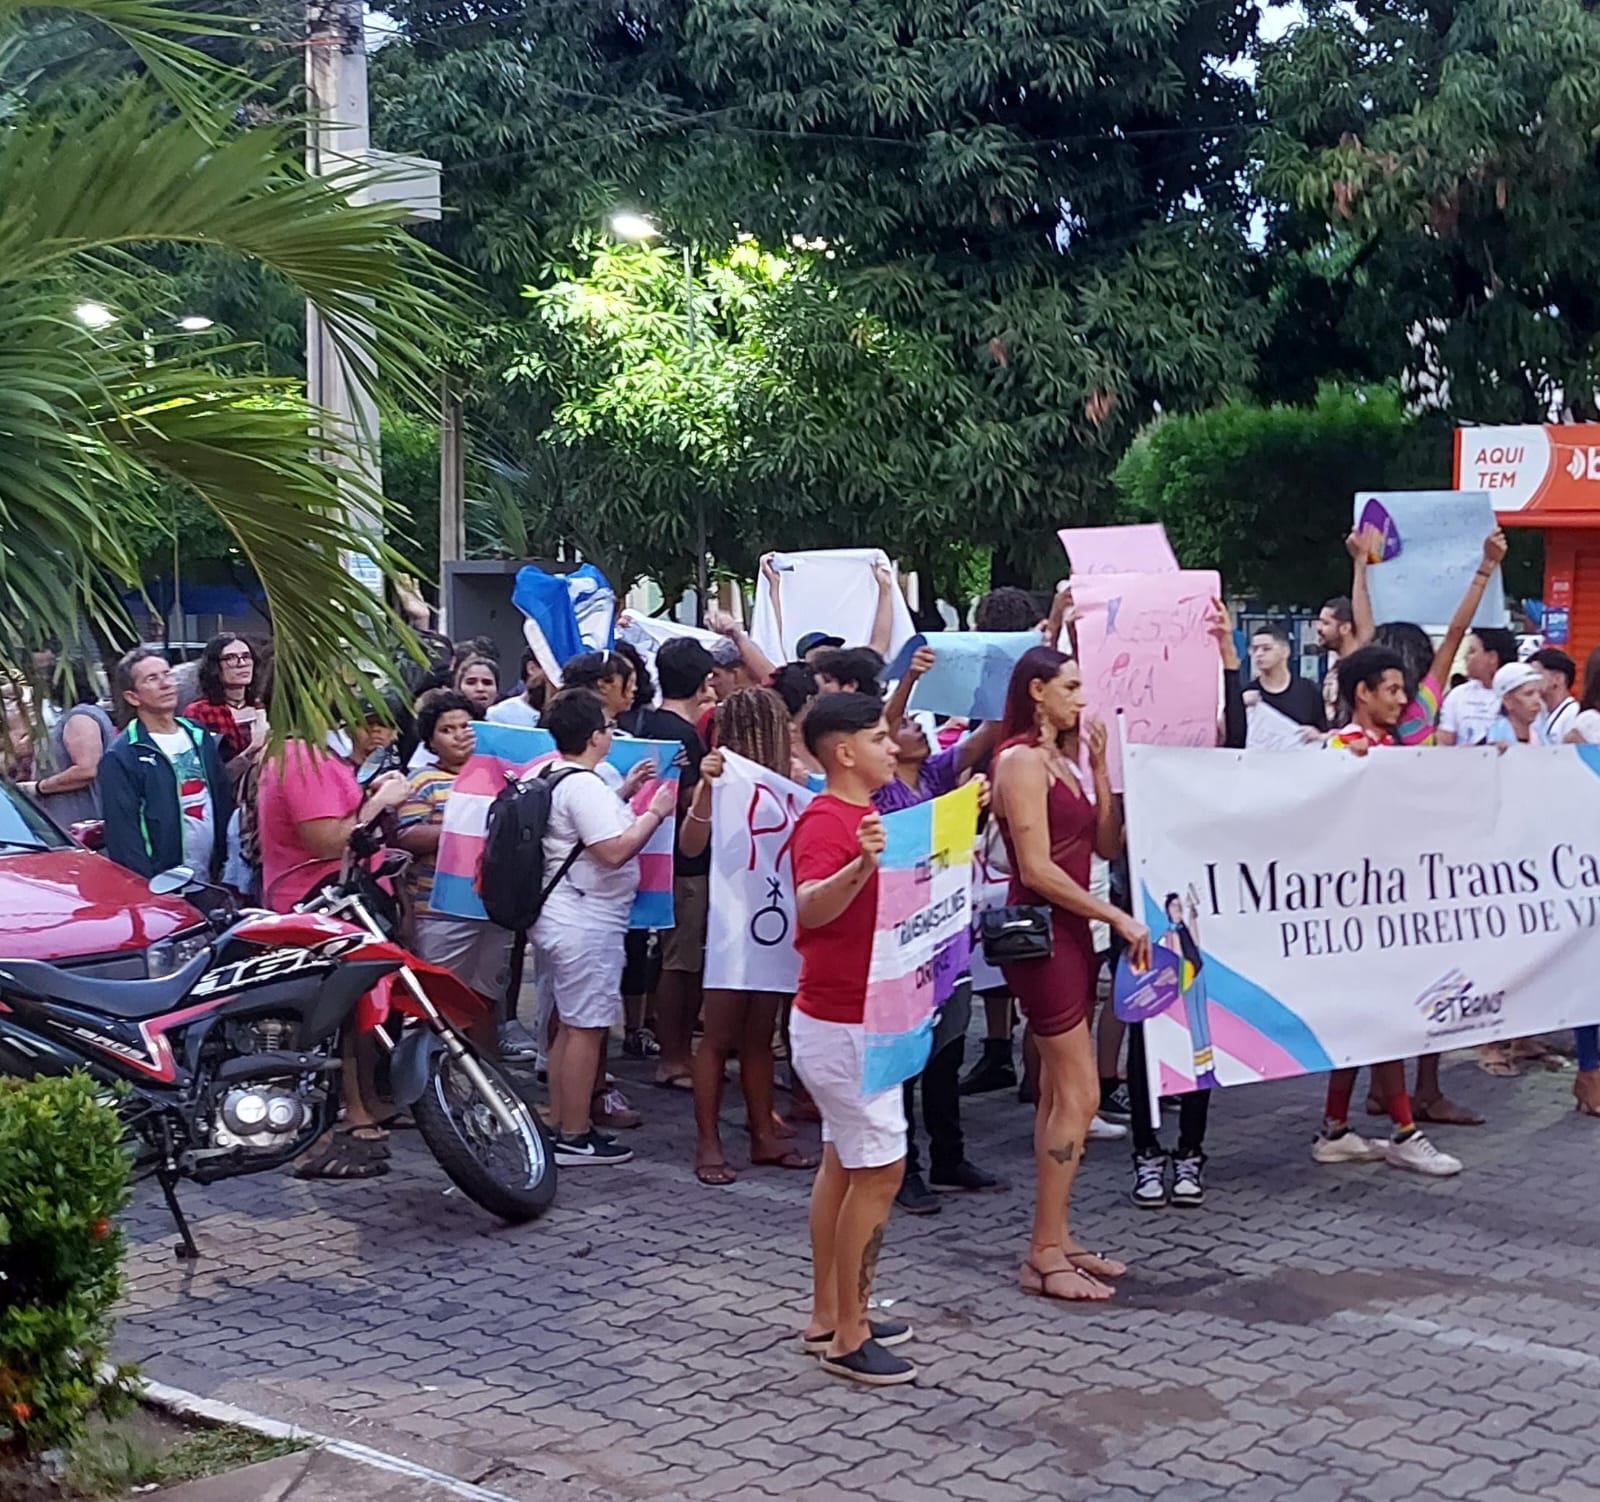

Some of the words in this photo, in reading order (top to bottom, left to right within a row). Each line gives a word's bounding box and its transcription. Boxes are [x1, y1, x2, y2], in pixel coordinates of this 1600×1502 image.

[1475, 446, 1525, 465] AQUI
[1478, 471, 1516, 488] TEM
[1204, 862, 1222, 916] I
[1237, 857, 1407, 915] Marcha
[1419, 852, 1540, 900] Trans
[1551, 843, 1600, 890] Ca
[1280, 916, 1363, 958] PELO
[1377, 904, 1506, 949] DIREITO
[1518, 899, 1560, 935] DE
[1566, 896, 1600, 928] VI
